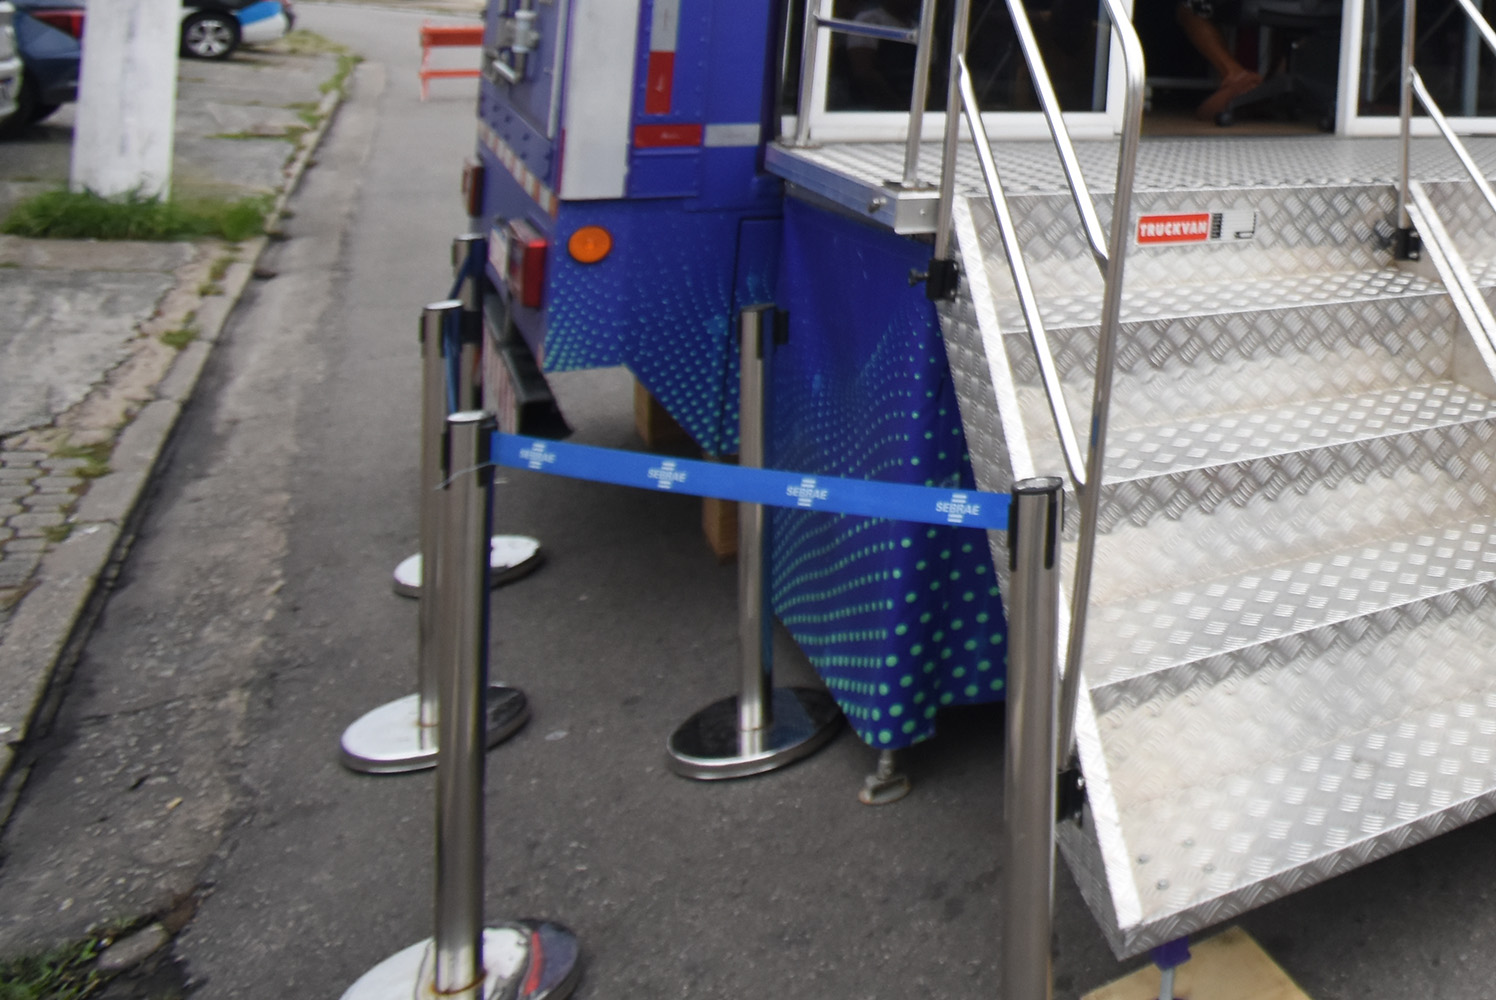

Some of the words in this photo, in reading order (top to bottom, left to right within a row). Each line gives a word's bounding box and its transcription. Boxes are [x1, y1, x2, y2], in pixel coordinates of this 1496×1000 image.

[1140, 221, 1207, 237] TRUCKVAN
[786, 486, 828, 500] SEBRAE
[935, 502, 980, 516] SEBRAE
